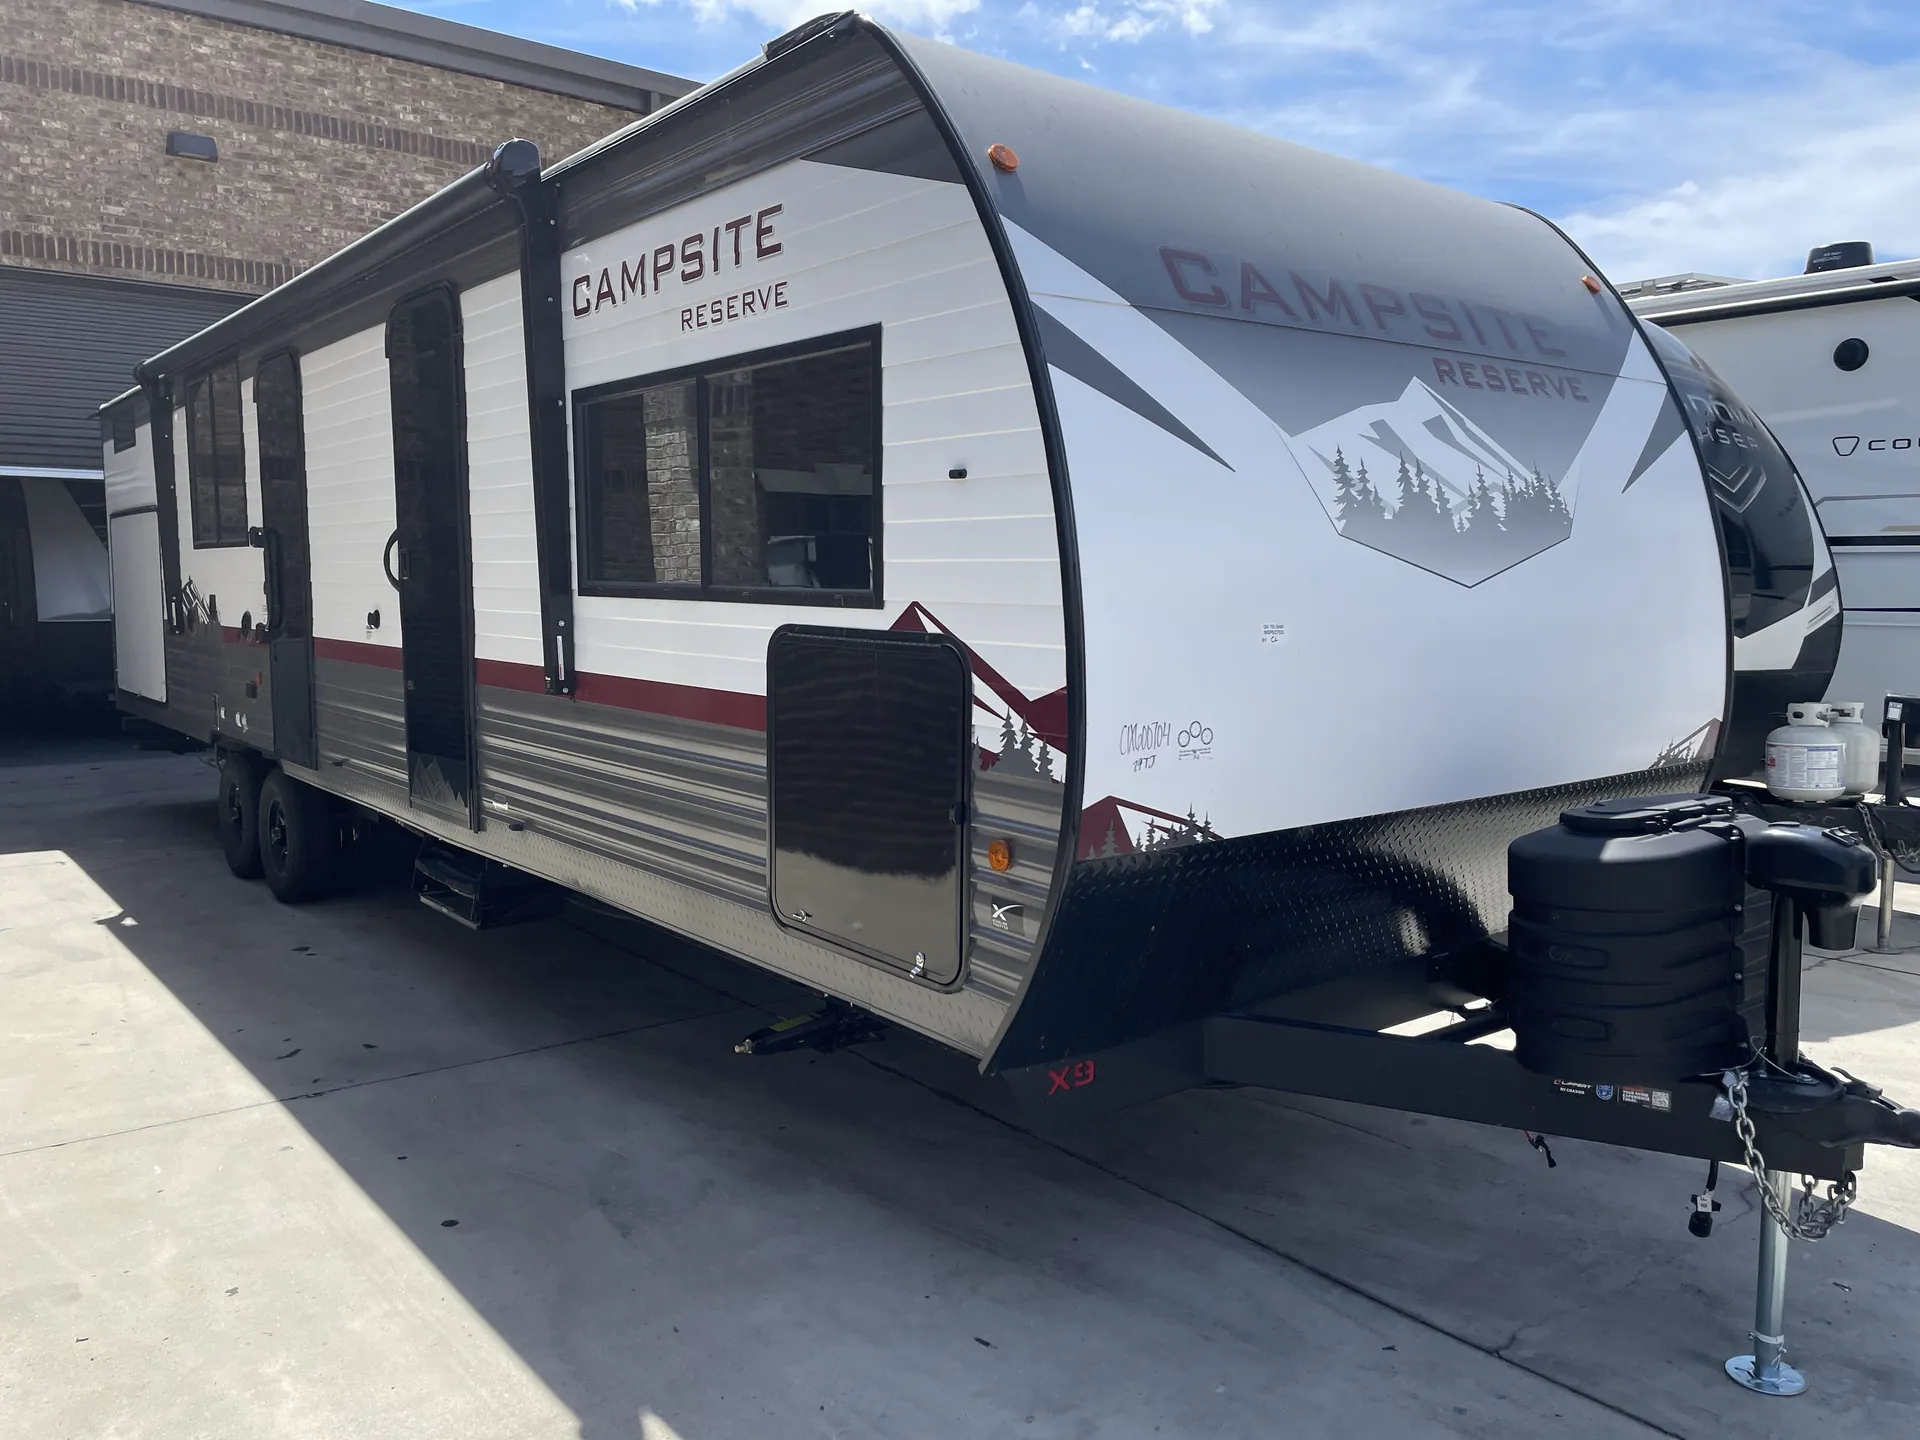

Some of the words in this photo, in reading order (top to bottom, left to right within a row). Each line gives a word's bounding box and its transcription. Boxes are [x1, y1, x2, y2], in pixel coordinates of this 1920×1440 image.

[572, 203, 785, 319] CAMPSITE
[680, 279, 788, 332] RESERVE
[1158, 244, 1568, 358] CAMPSITE
[1431, 356, 1590, 404] RESERVE
[1868, 437, 1920, 451] CO
[1561, 1080, 1592, 1089] LIPPERT
